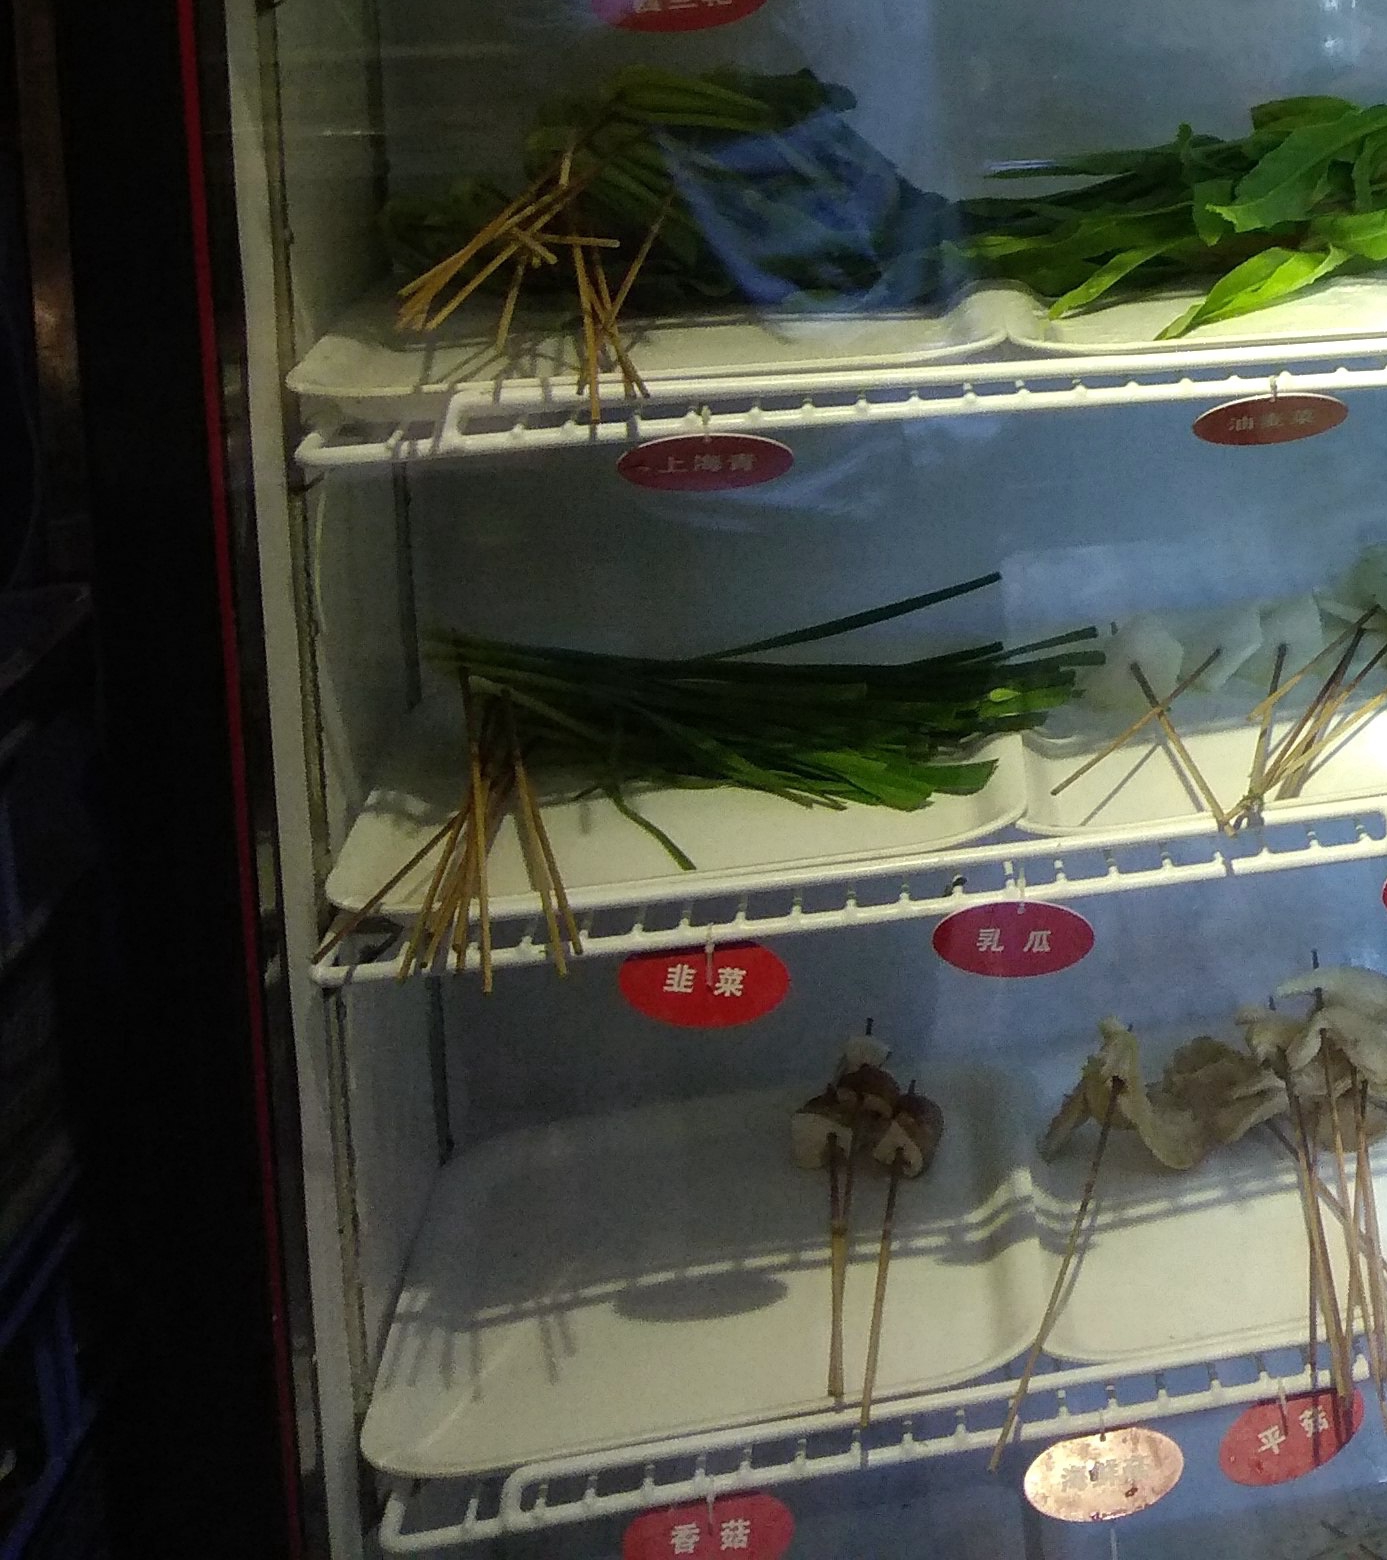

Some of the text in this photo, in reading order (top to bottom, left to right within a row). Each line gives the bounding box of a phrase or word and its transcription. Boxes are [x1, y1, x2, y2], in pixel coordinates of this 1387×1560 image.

[658, 452, 758, 475] 上海青
[976, 927, 1052, 954] 乳瓜
[663, 963, 748, 999] 韭菜
[670, 1518, 752, 1556] 香菇
